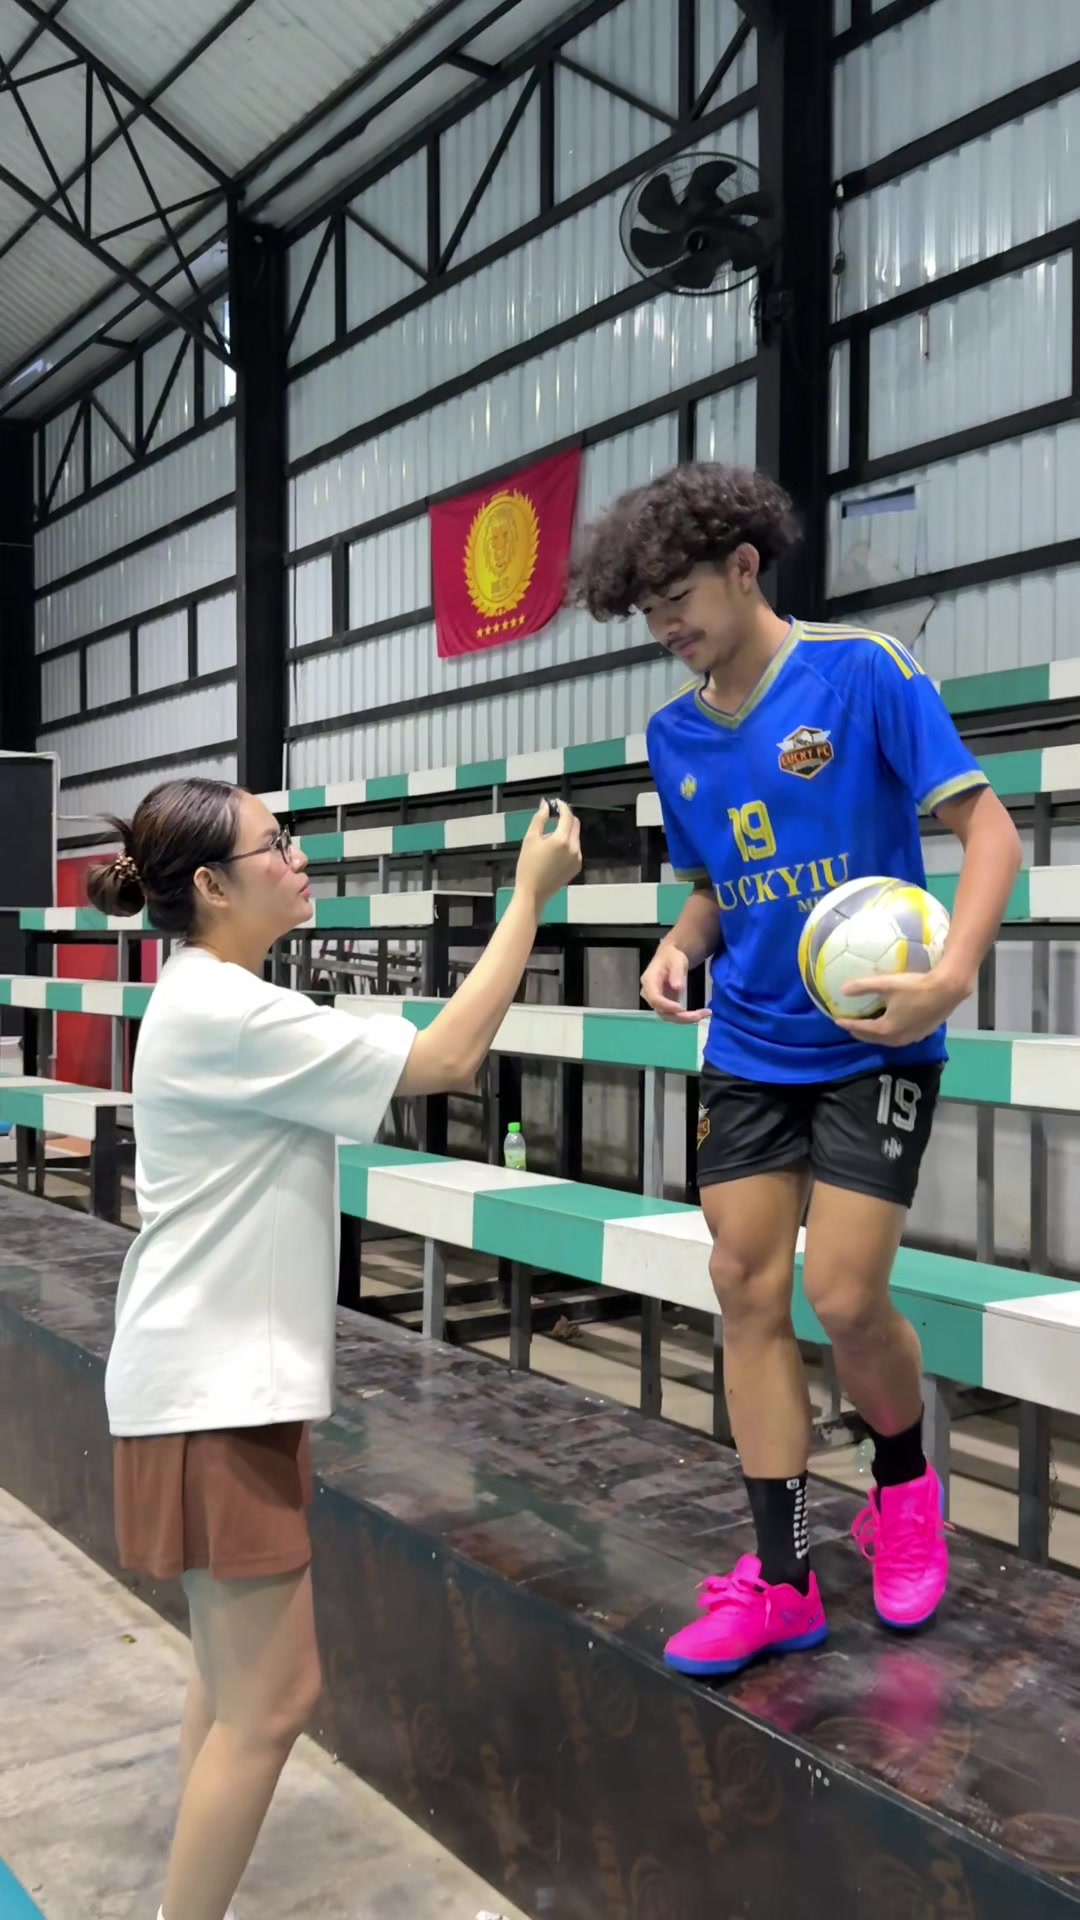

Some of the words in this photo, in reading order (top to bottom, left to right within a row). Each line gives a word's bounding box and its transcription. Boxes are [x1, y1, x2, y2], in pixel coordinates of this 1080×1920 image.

[781, 748, 813, 767] LUCKY
[816, 743, 831, 759] FC
[727, 800, 776, 862] 19
[877, 1074, 921, 1132] 19
